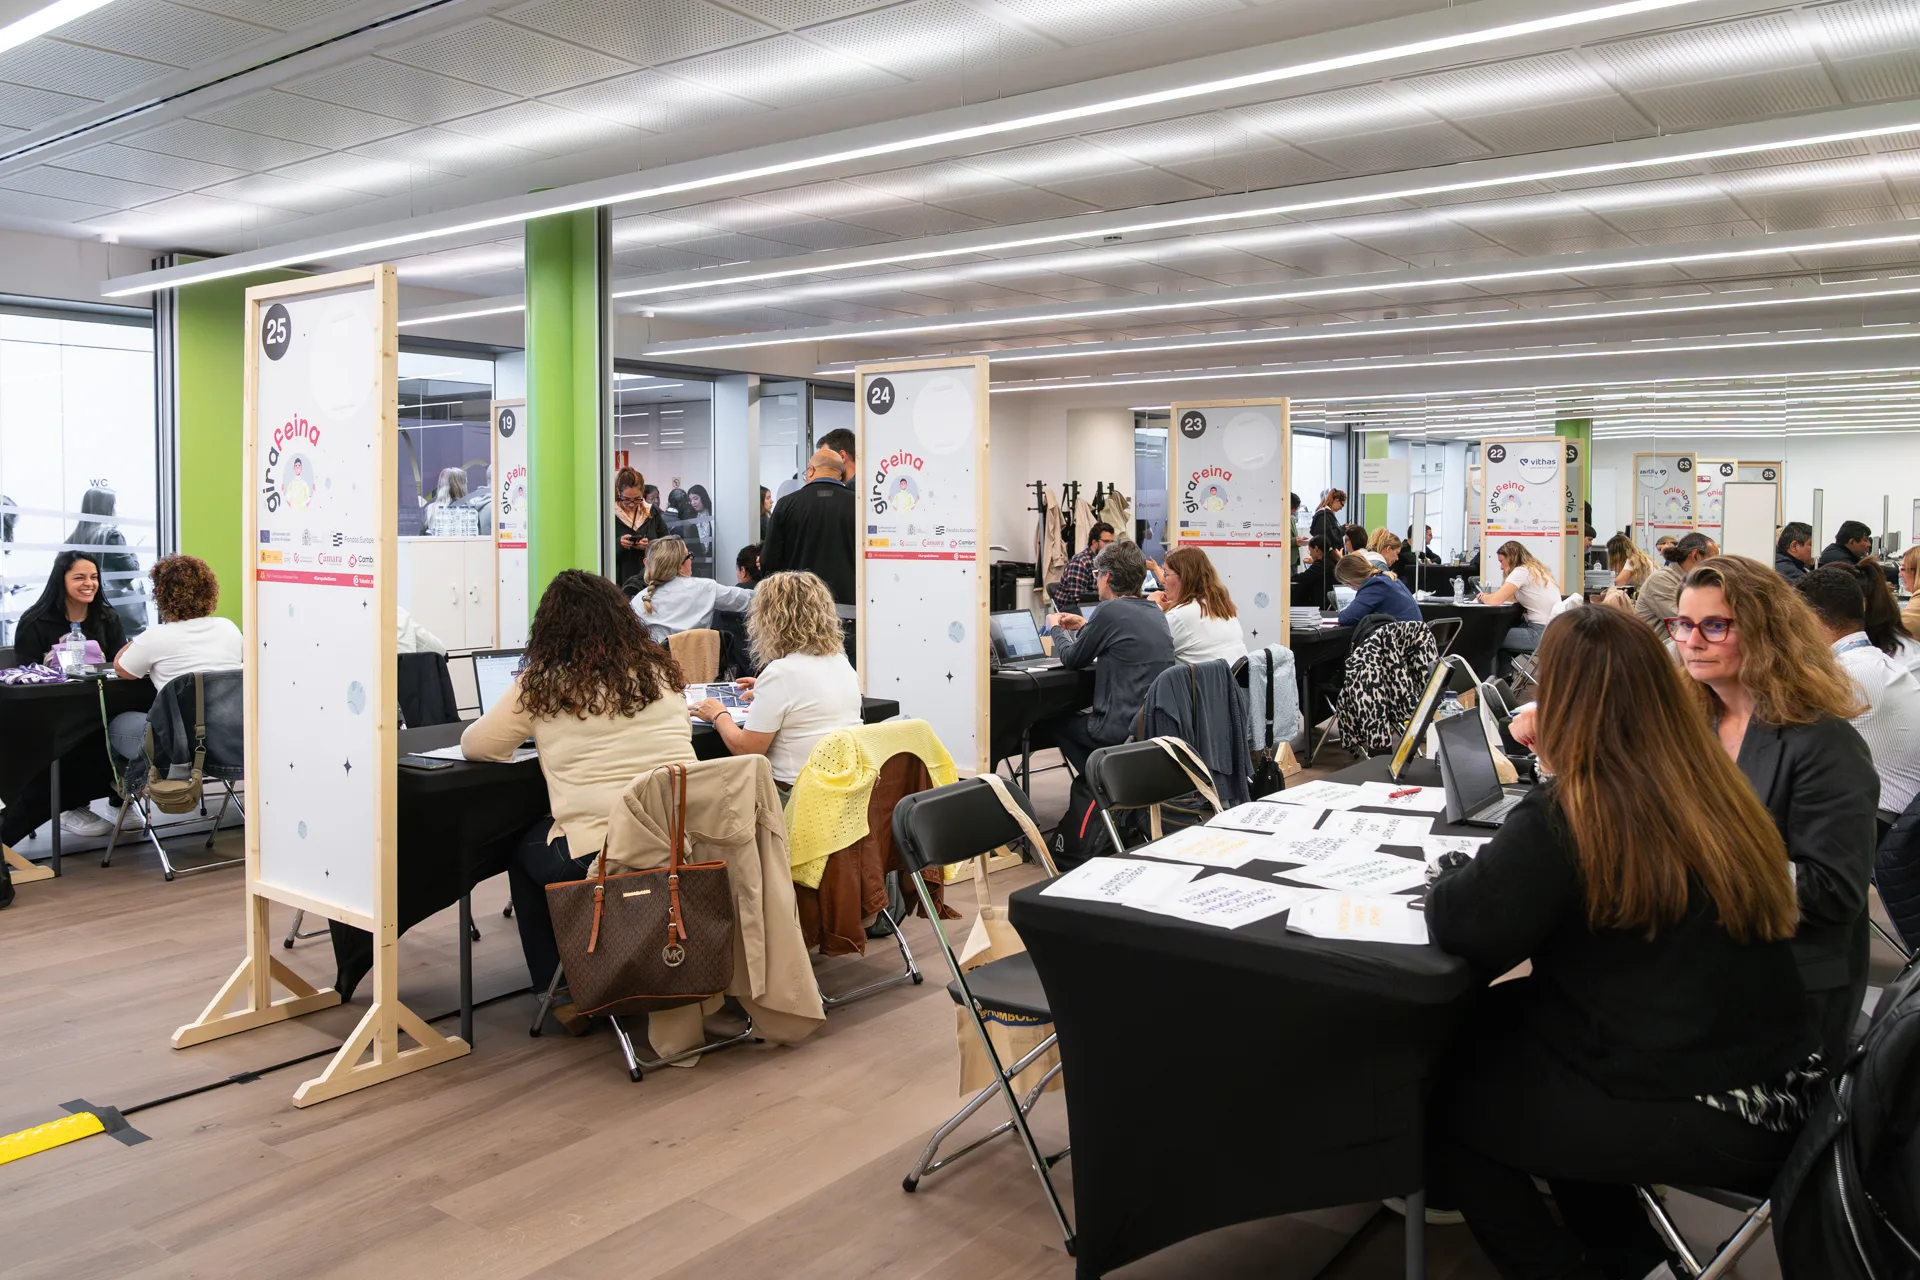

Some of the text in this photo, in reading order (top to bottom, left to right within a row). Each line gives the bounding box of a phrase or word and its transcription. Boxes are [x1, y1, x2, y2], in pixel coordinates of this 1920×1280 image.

[266, 318, 286, 344] 25
[871, 386, 890, 404] 24
[502, 415, 513, 430] 19
[1184, 418, 1202, 431] 23
[1490, 448, 1504, 458] 22
[1530, 458, 1556, 466] vithas
[90, 478, 108, 487] WC
[358, 554, 374, 563] Camb
[664, 950, 682, 961] MK
